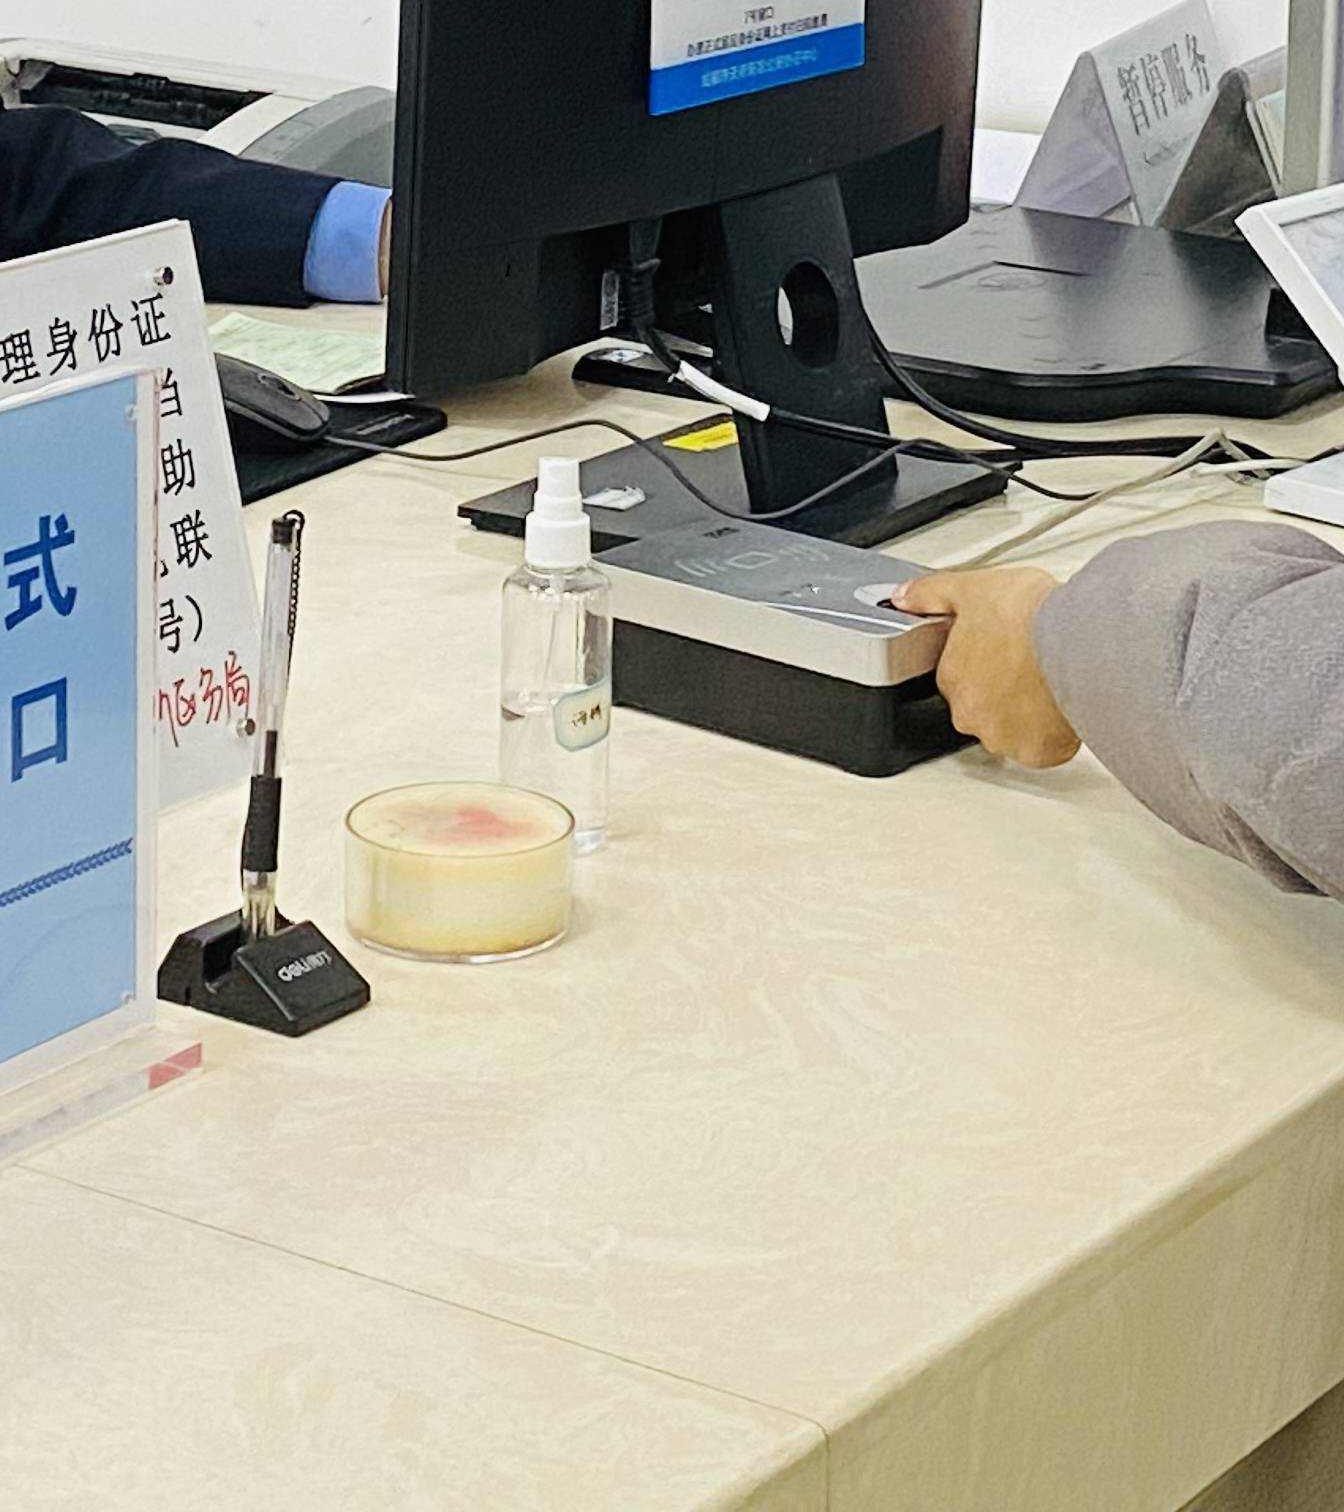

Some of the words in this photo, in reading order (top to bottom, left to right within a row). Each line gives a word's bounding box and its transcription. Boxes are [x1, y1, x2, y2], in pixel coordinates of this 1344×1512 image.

[1118, 33, 1210, 136] 暂停服务
[161, 438, 196, 496] 助
